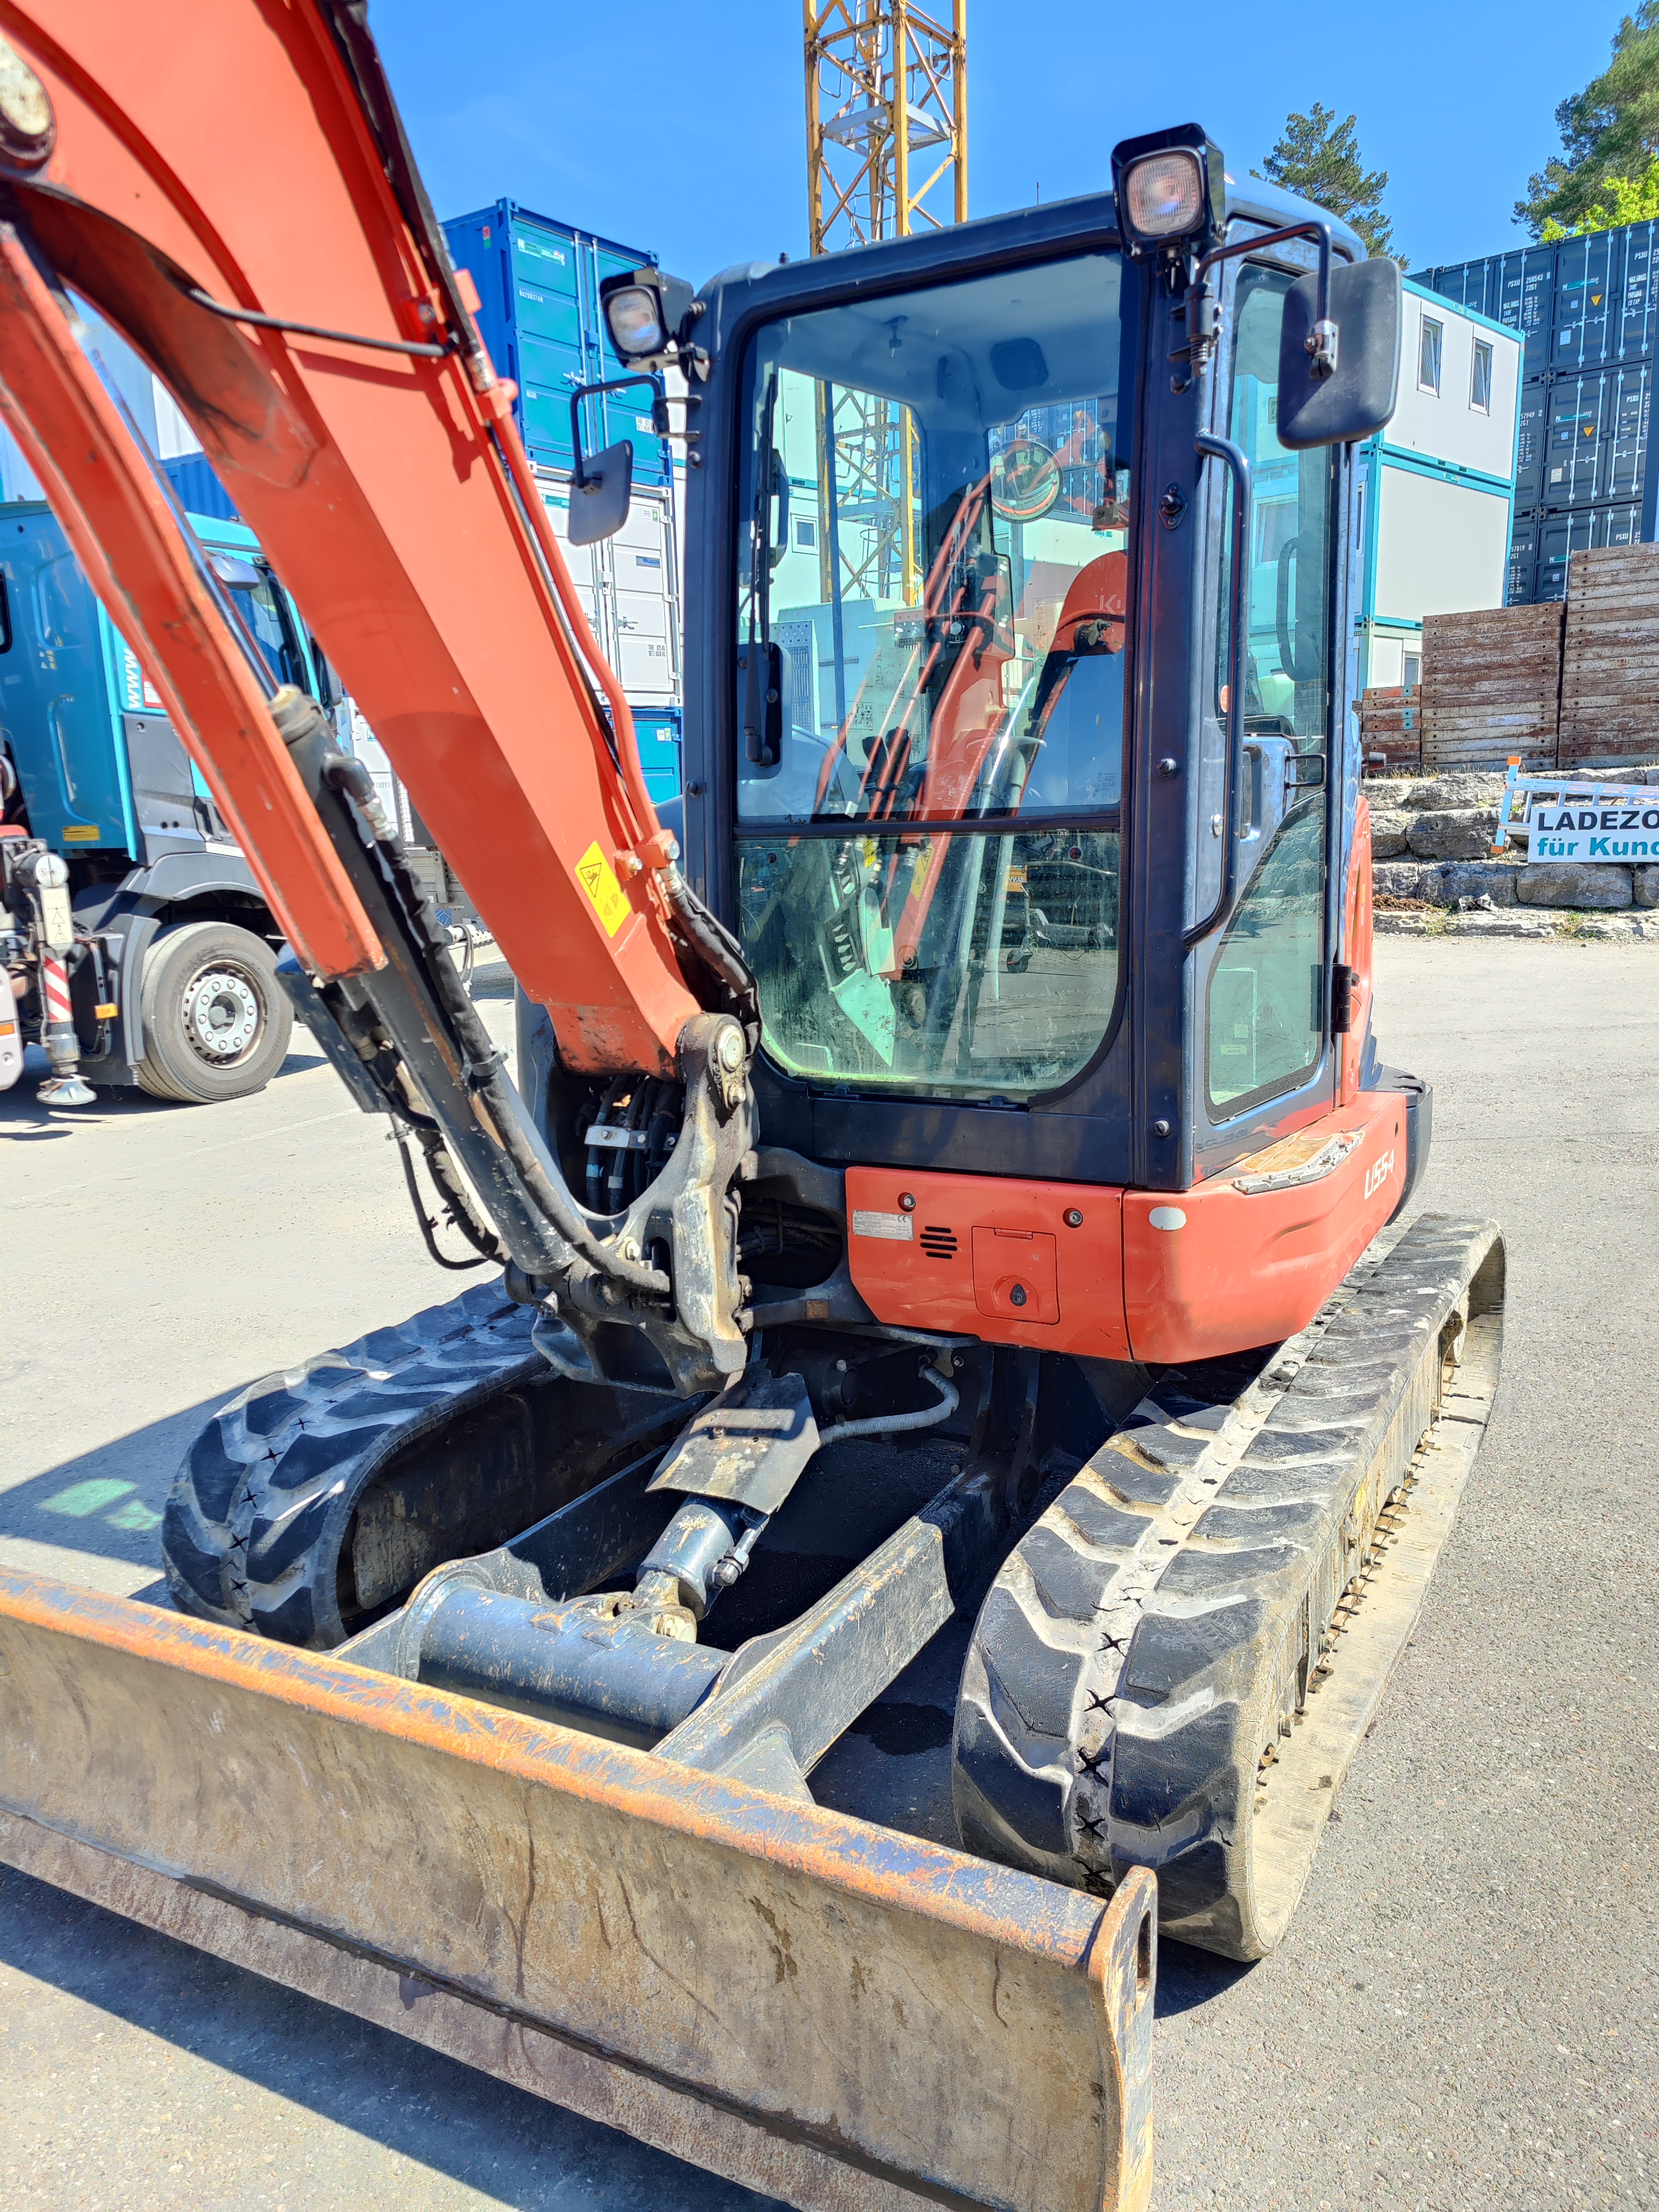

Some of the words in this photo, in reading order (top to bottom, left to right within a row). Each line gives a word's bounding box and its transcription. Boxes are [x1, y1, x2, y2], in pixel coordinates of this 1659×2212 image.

[1635, 251, 1647, 260] PSXU
[1507, 279, 1520, 289] PSXU
[1525, 274, 1543, 284] 256543
[1525, 283, 1537, 292] 22G1
[1626, 394, 1639, 403] PSXU
[1537, 810, 1659, 831] LADEZO
[1537, 837, 1579, 856] für
